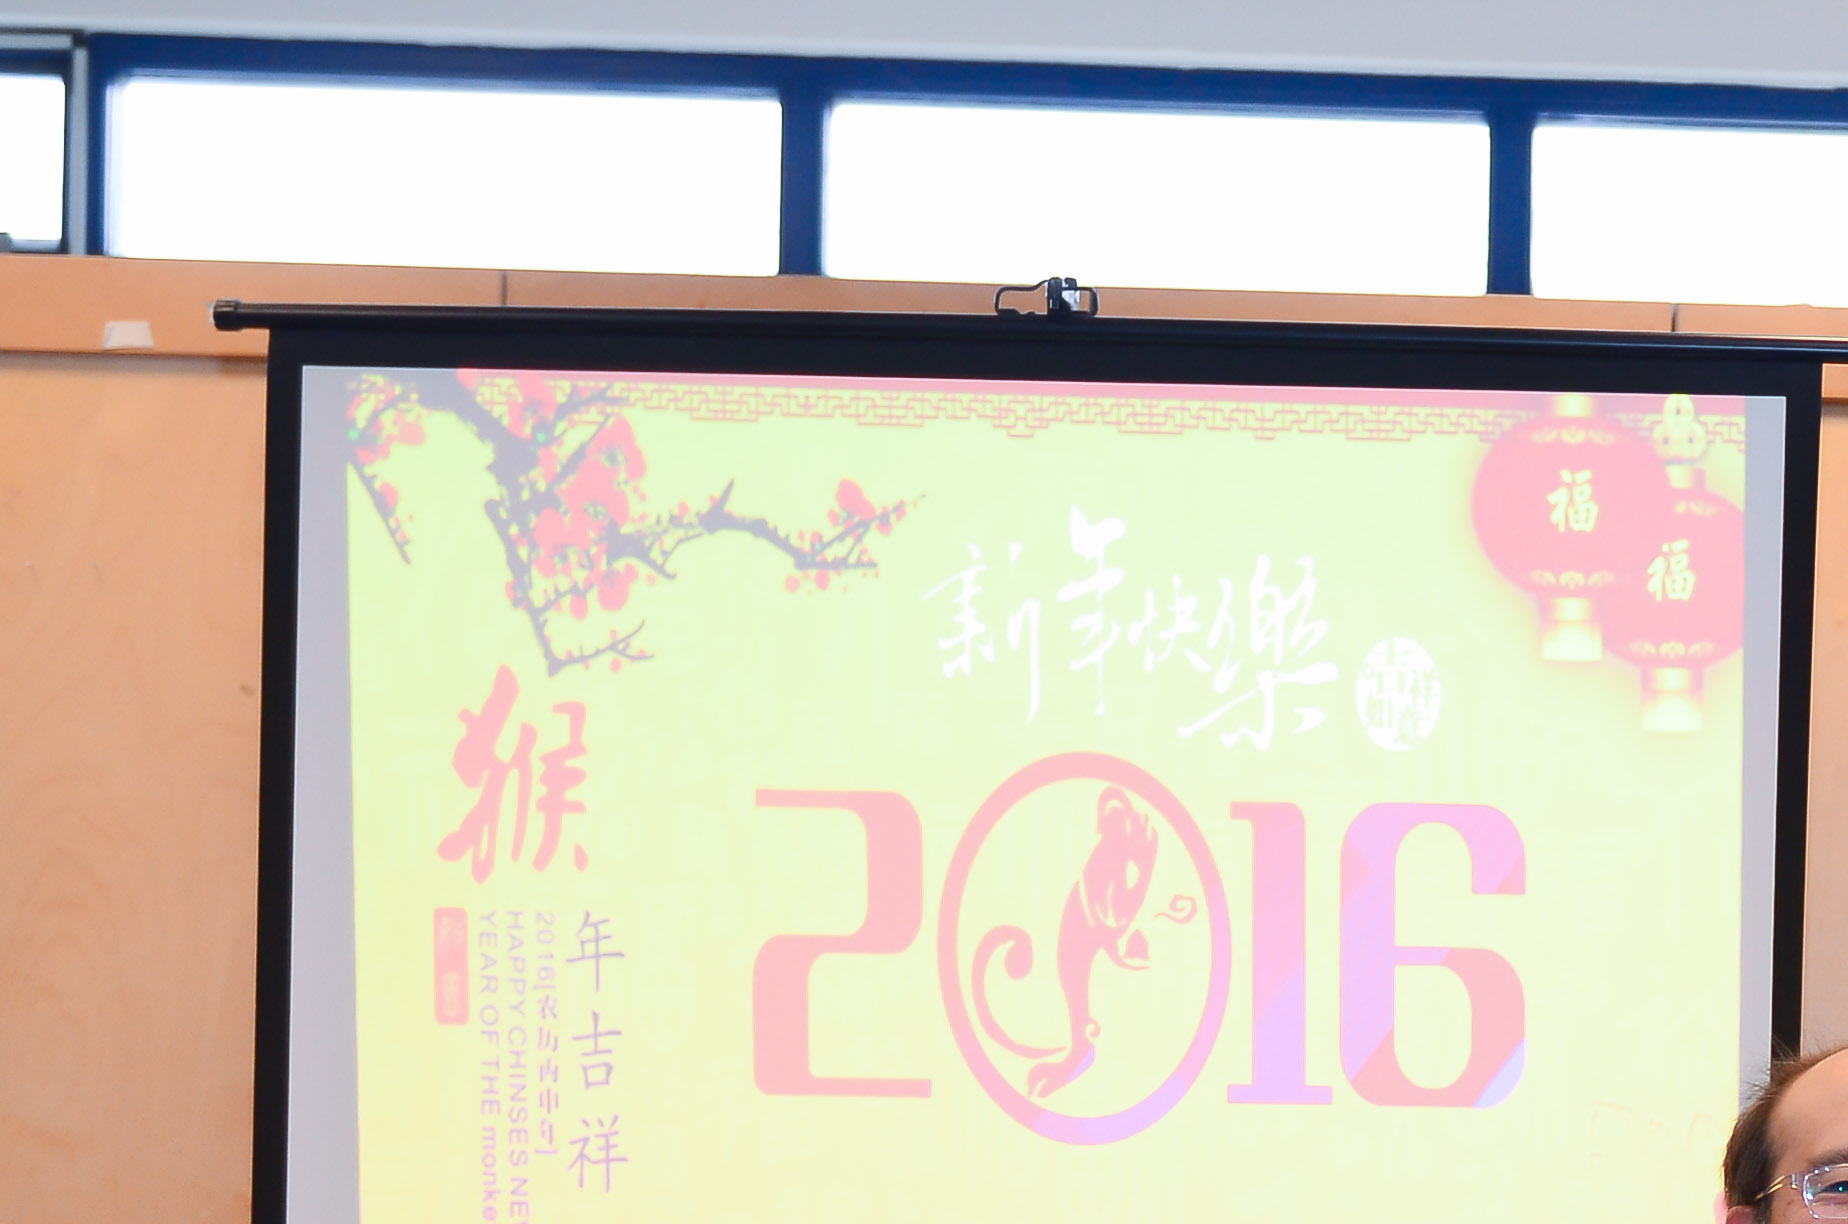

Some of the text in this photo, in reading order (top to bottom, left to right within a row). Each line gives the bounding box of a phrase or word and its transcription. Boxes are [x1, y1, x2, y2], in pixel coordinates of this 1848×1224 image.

[1546, 468, 1600, 533] 福
[1646, 538, 1697, 602] 福
[436, 663, 590, 885] 猴
[478, 909, 499, 994] YEAR
[505, 910, 527, 1017] HAPPY
[753, 751, 1526, 1146] 2016
[479, 1004, 501, 1045] OF
[480, 1055, 502, 1116] THE
[507, 1025, 530, 1168] CHINSES
